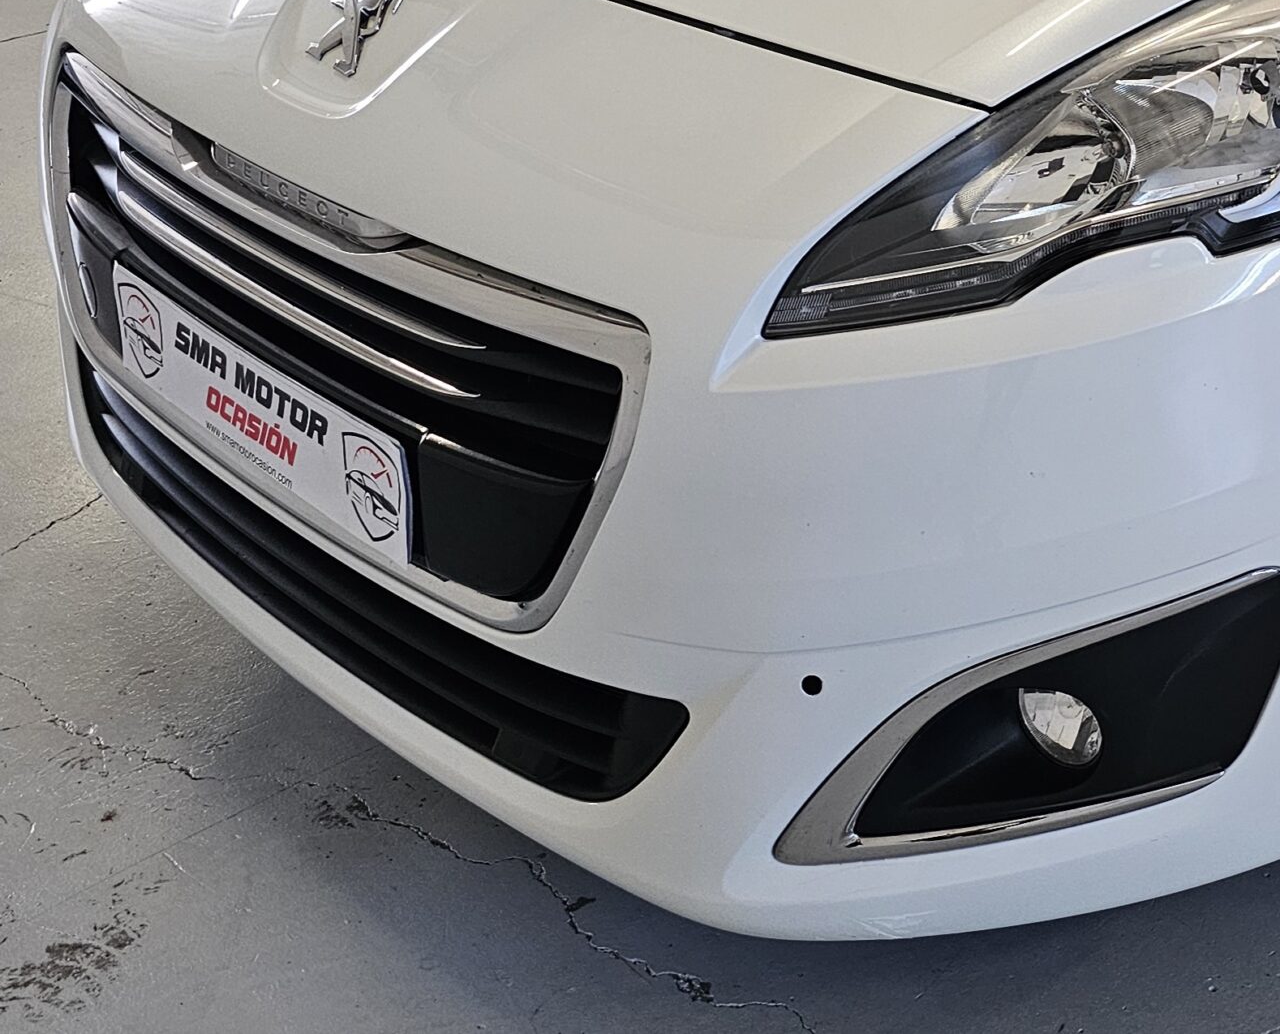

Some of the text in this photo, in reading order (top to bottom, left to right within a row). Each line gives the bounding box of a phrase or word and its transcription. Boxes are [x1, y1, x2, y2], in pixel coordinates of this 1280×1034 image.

[225, 152, 350, 226] PEUGEOT
[174, 320, 328, 446] SMA MOTOR
[205, 384, 298, 467] OCASIÓN
[205, 420, 293, 490] www.smamotorocasion.com
